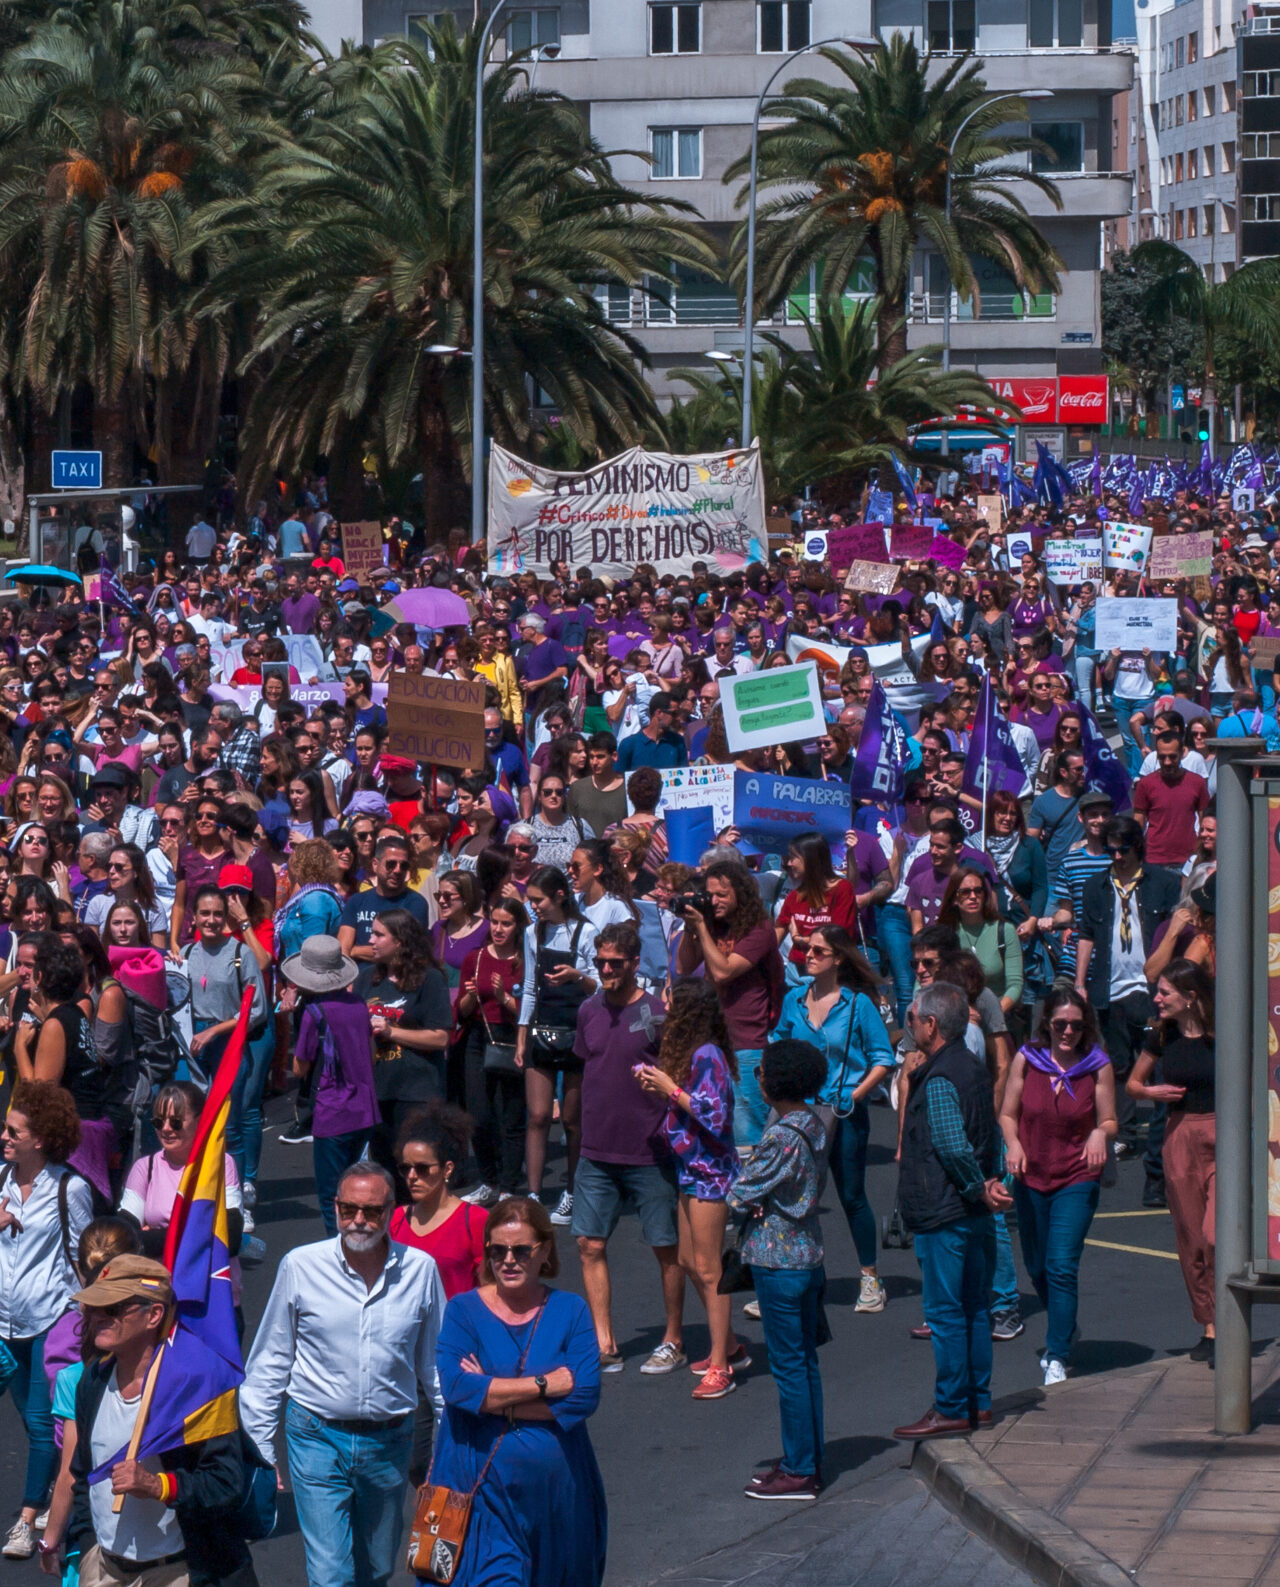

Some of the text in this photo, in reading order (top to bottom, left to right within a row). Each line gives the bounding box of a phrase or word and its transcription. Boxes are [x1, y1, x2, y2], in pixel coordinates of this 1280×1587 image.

[60, 461, 95, 477] TAXI
[553, 462, 690, 497] FEMINISMO
[535, 520, 715, 564] POR DERECHO(S)
[1046, 540, 1086, 549] Mientras
[1074, 548, 1101, 558] MUJER
[1080, 566, 1102, 580] LIBRE
[249, 689, 331, 701] 8 Marzo
[391, 676, 480, 704] EDUCACIÓN
[745, 778, 760, 795] A
[773, 781, 851, 808] PALABRAS
